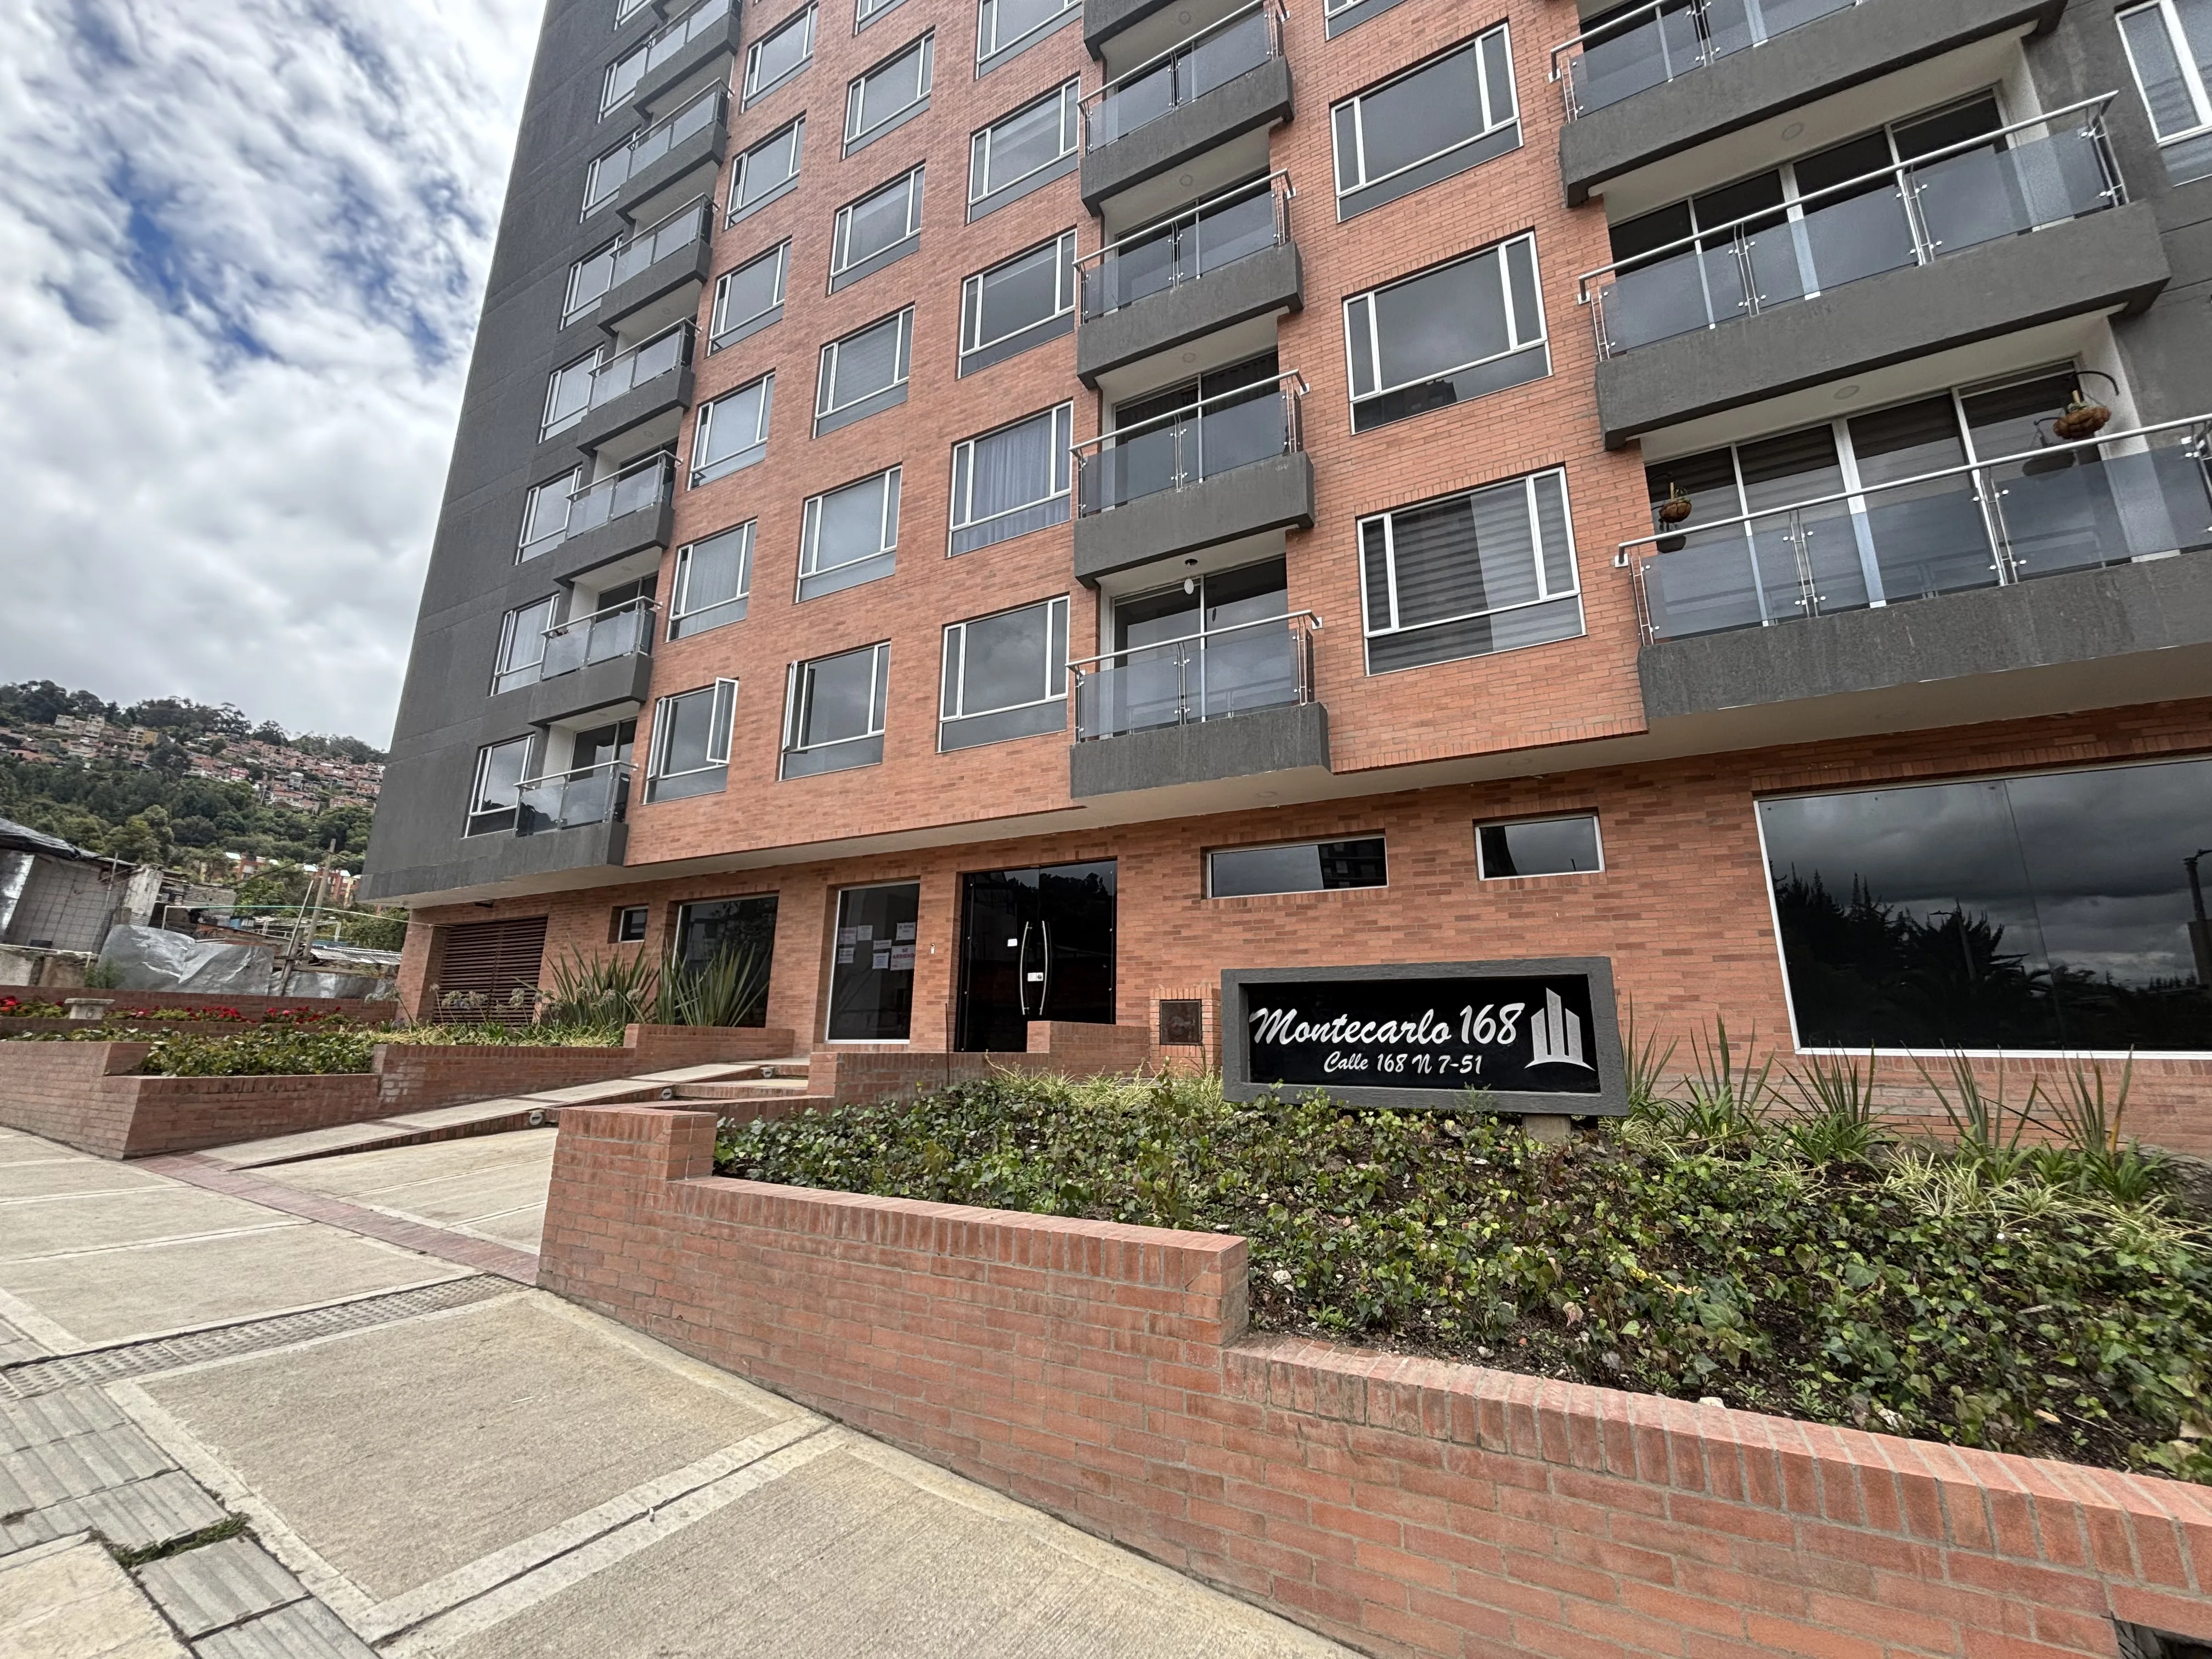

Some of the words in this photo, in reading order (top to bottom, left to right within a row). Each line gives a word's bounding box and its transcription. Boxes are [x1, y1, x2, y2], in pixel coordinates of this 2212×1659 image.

[1249, 1007, 1452, 1045] Montecarlo
[1459, 1002, 1526, 1045] 168
[1323, 1051, 1369, 1073] Calle
[1377, 1053, 1408, 1073] 168
[1412, 1053, 1432, 1074] N
[1438, 1054, 1482, 1074] 7-51
